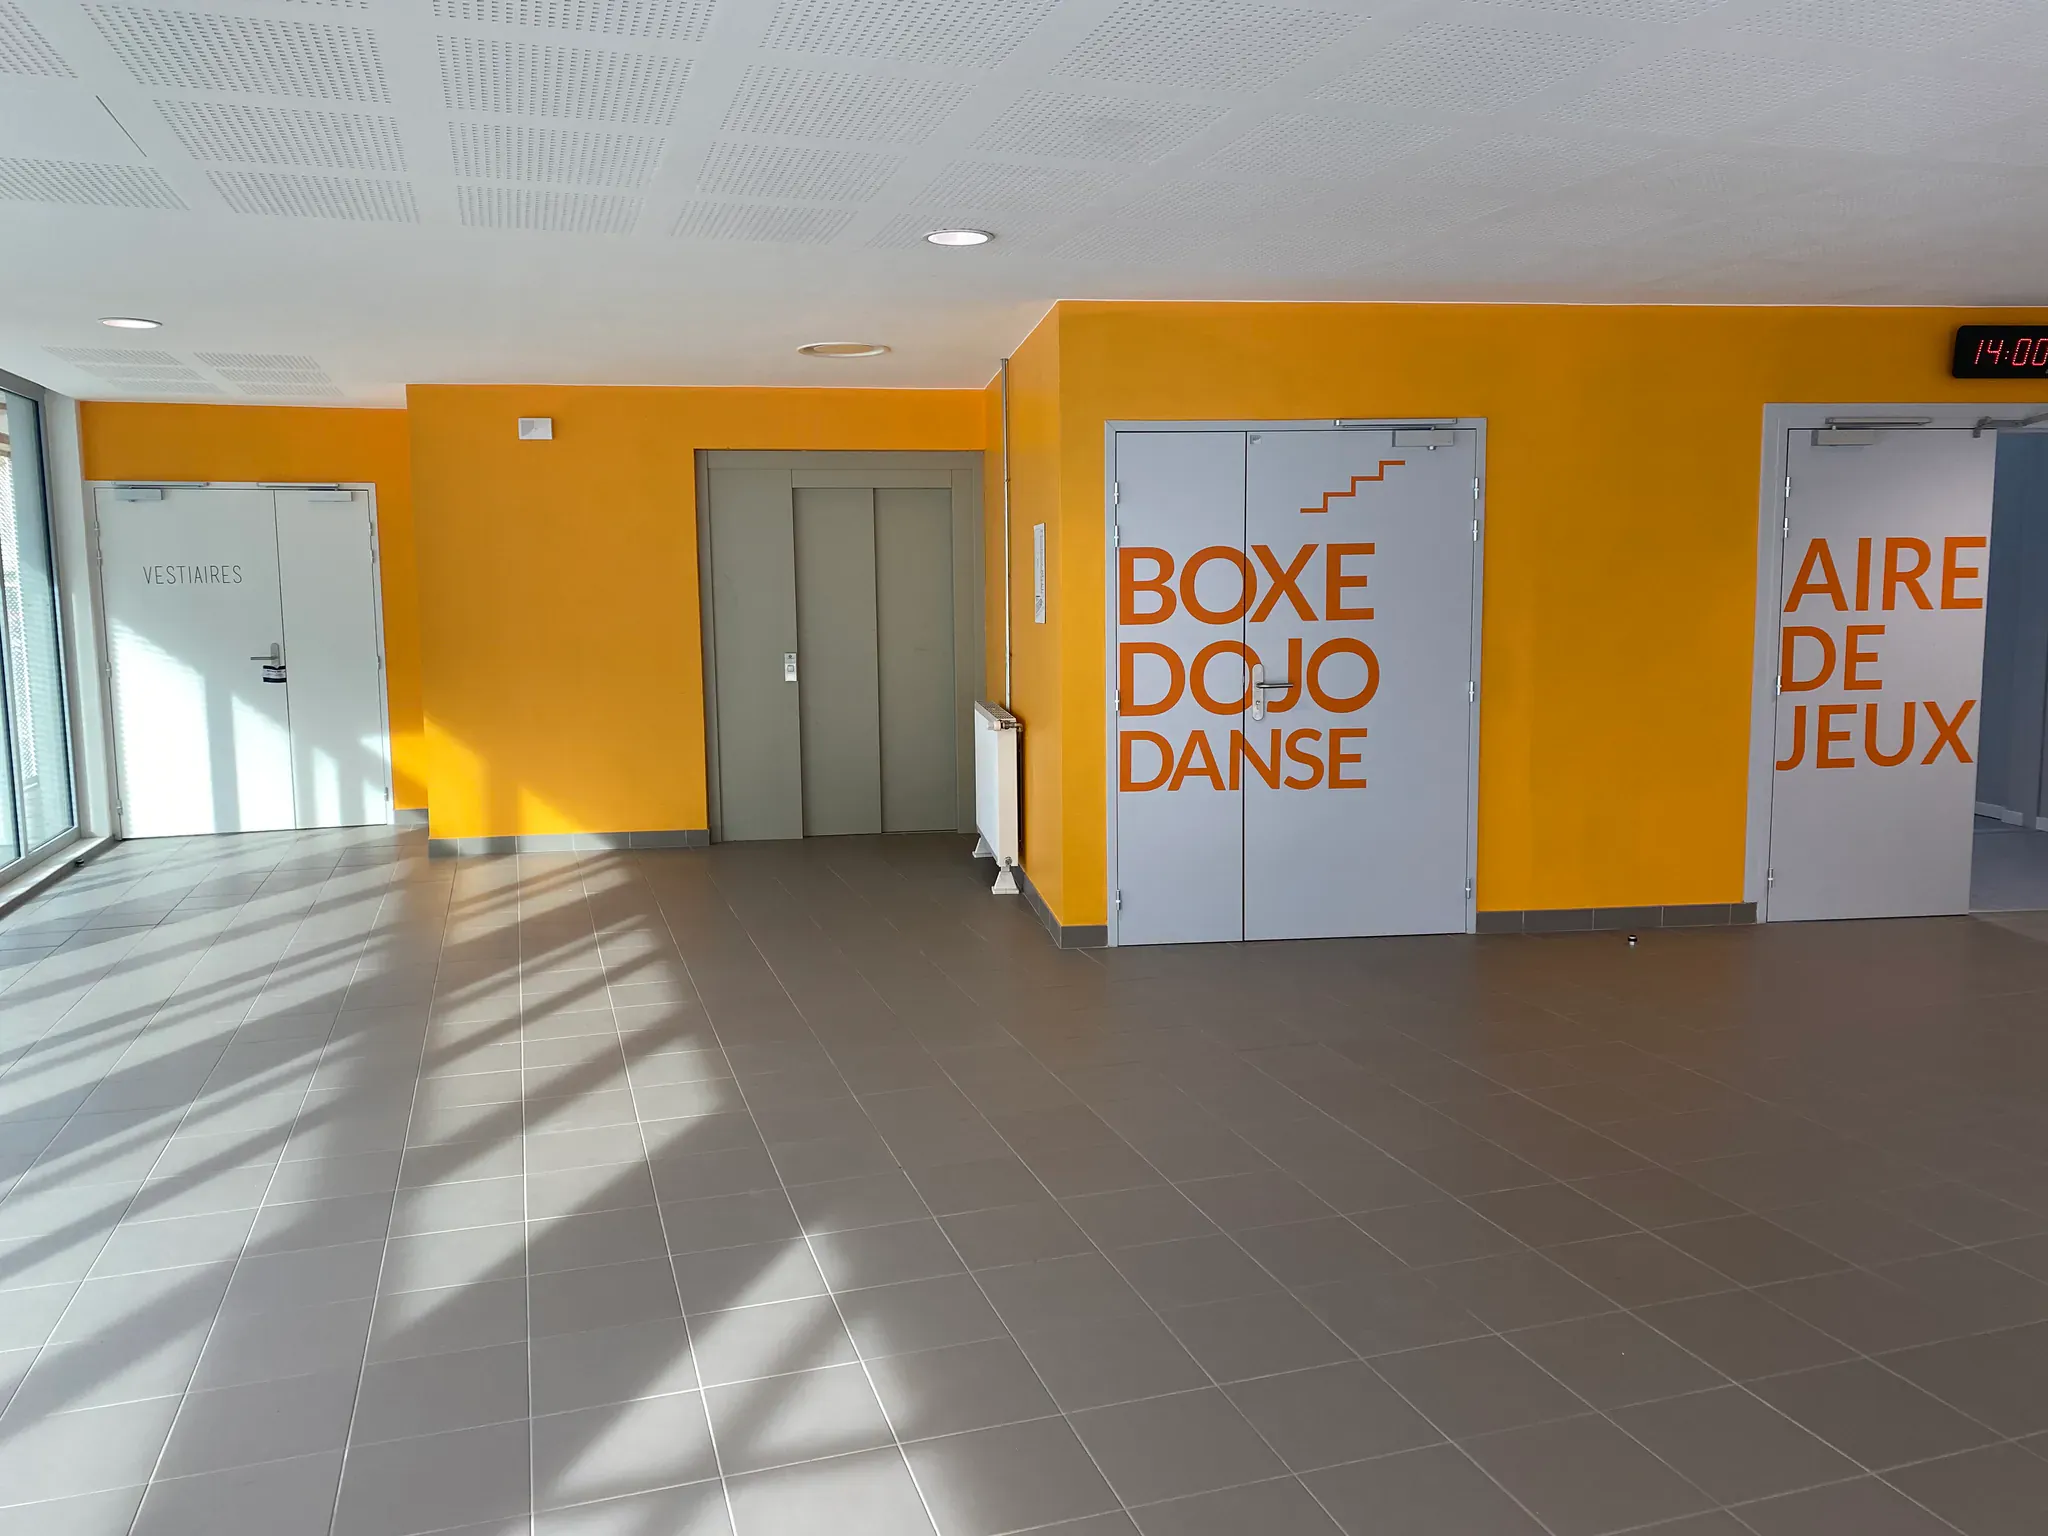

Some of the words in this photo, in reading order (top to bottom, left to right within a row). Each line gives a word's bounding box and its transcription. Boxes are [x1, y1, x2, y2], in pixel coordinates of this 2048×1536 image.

[1973, 338, 2048, 367] 14:00
[142, 564, 243, 585] VESTIAIRES
[1119, 543, 1375, 625] BOXE
[1783, 536, 1987, 612] AIRE
[1119, 637, 1380, 717] DOJO
[1780, 625, 1886, 692] DE
[1119, 728, 1368, 793] DANSE
[1775, 700, 1977, 771] JEUX
